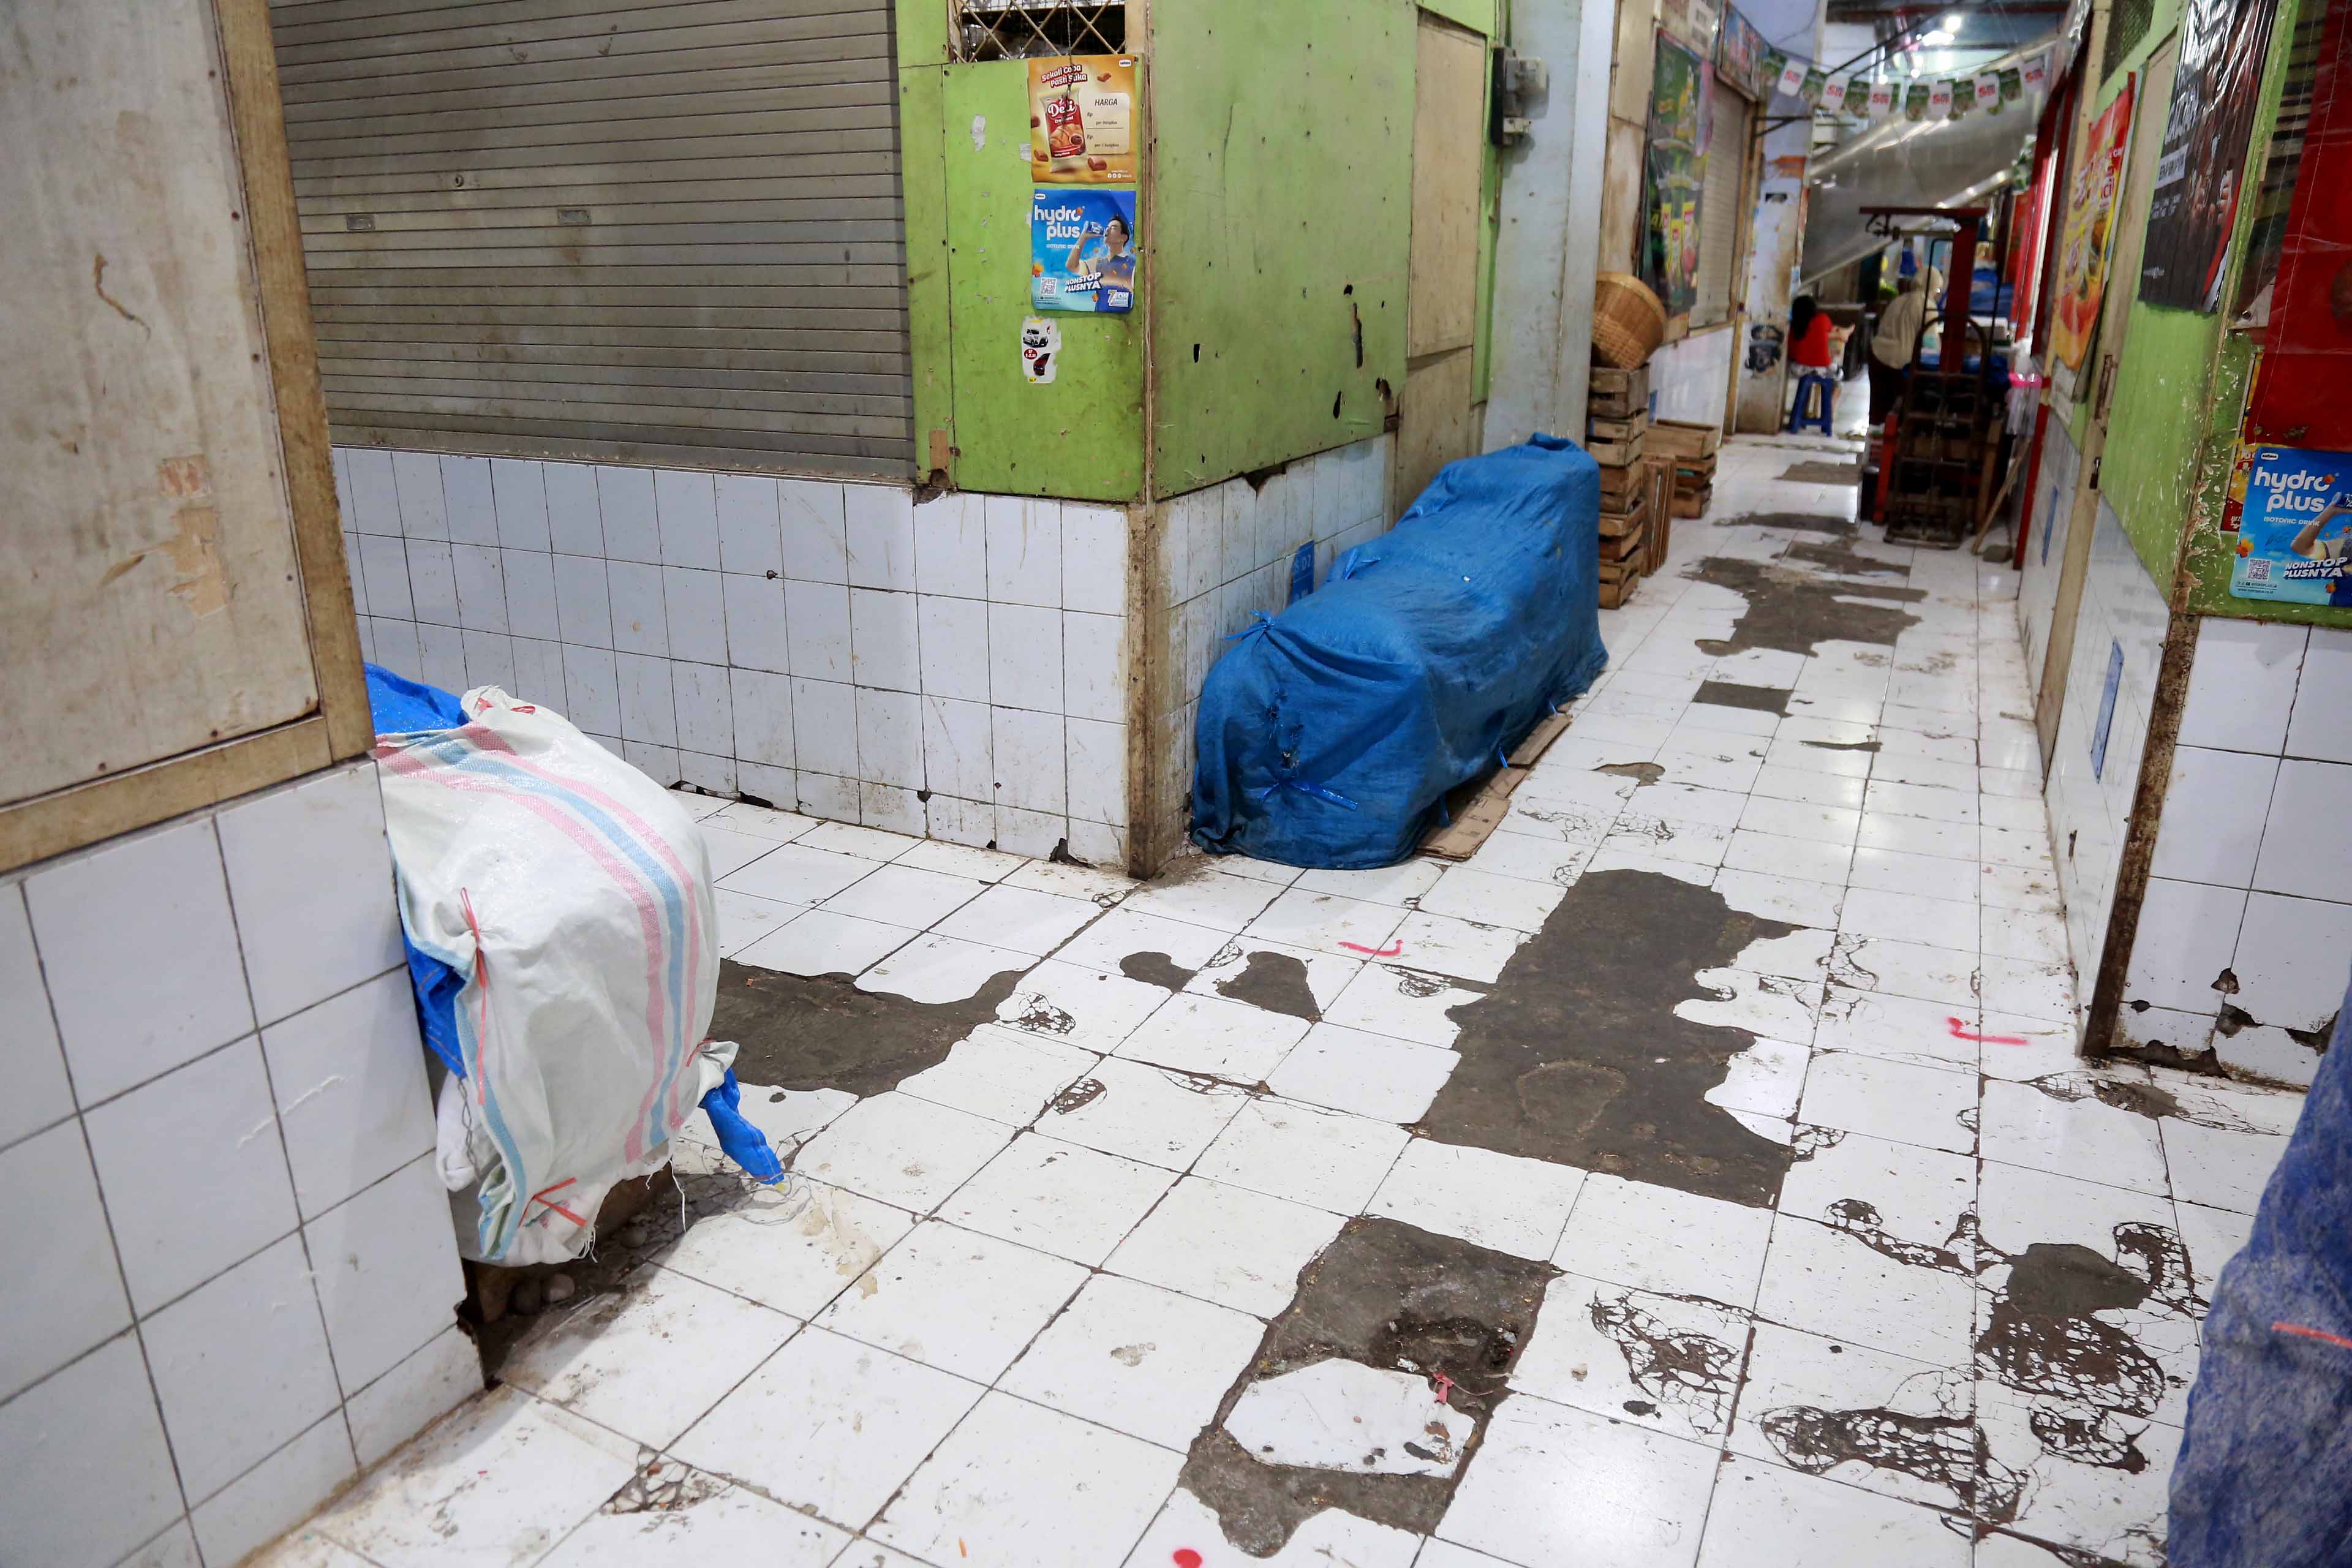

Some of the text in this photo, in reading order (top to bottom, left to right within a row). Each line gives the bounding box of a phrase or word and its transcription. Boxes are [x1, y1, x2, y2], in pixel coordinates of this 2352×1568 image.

[1048, 100, 1076, 117] Dei
[1035, 205, 1082, 225] hydro
[1047, 222, 1080, 241] plus
[1066, 272, 1101, 285] NONSTOP
[1065, 281, 1101, 292] PLUSNYA
[2254, 466, 2331, 494] hydro
[2266, 491, 2325, 513] plus
[2263, 516, 2297, 525] ISOTONIC
[2285, 557, 2348, 570] NONSTOP
[2283, 567, 2343, 578] PLUSNYA
